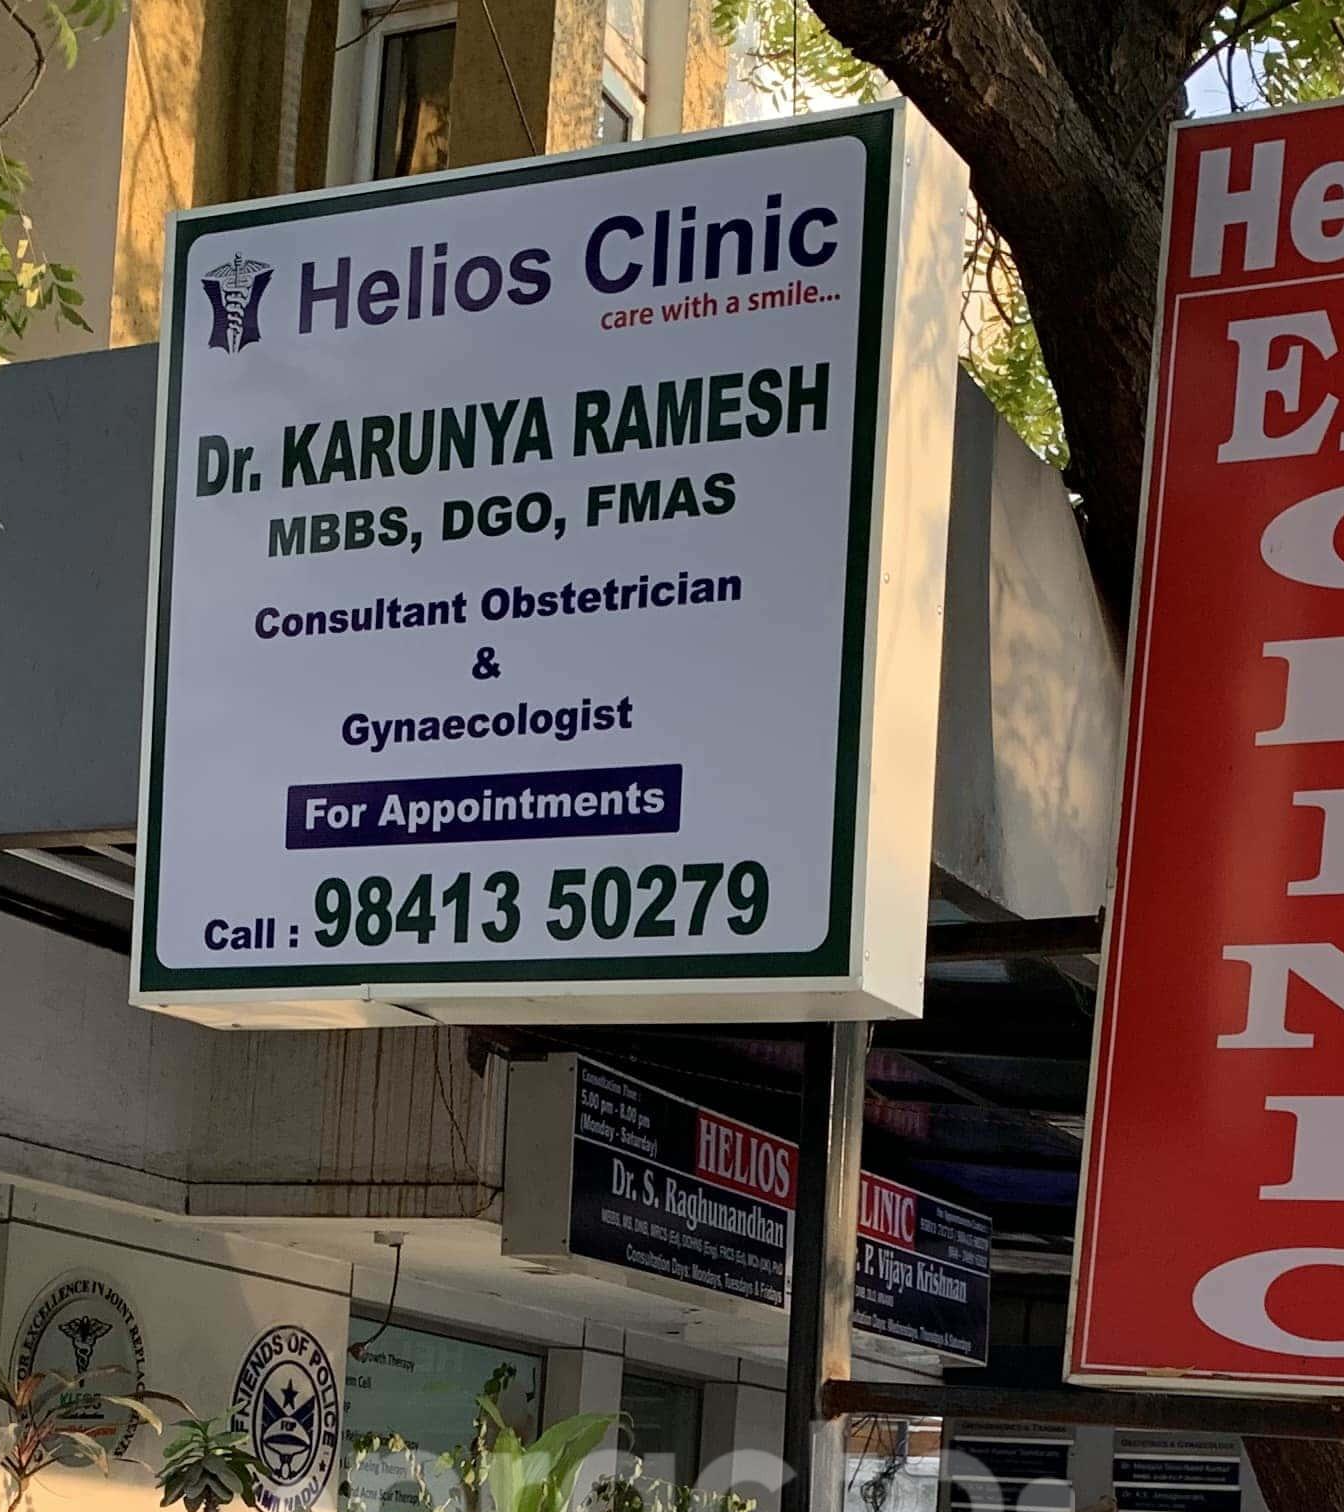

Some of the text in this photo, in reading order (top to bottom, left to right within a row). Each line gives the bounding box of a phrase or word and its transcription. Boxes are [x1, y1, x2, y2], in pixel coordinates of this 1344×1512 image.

[298, 193, 840, 335] Helios Clinic
[599, 280, 842, 332] care with a smile...
[196, 361, 831, 498] Dr. KARUNYA RAMESH
[267, 472, 737, 558] MBBS, DGO, FMAS
[254, 571, 743, 641] Consultant Obstetrician
[471, 646, 501, 681] &
[341, 695, 634, 754] Gynaecologist
[303, 780, 666, 833] For Appointments
[203, 917, 277, 953] Call
[313, 869, 522, 951] 98413
[545, 859, 770, 941] 50279
[697, 1117, 790, 1199] HELIOS
[611, 1156, 785, 1250] Dr. S. Raghunandhan
[857, 1180, 915, 1244] LINIC
[864, 1242, 875, 1276] P.
[877, 1247, 913, 1294] Vijaya
[915, 1260, 968, 1305] Krishnan
[23, 1279, 91, 1354] EXCELLENCE
[104, 1286, 135, 1326] JOINT
[287, 1333, 310, 1356] OF
[309, 1349, 336, 1448] POLICE
[387, 1353, 415, 1374] Therapy
